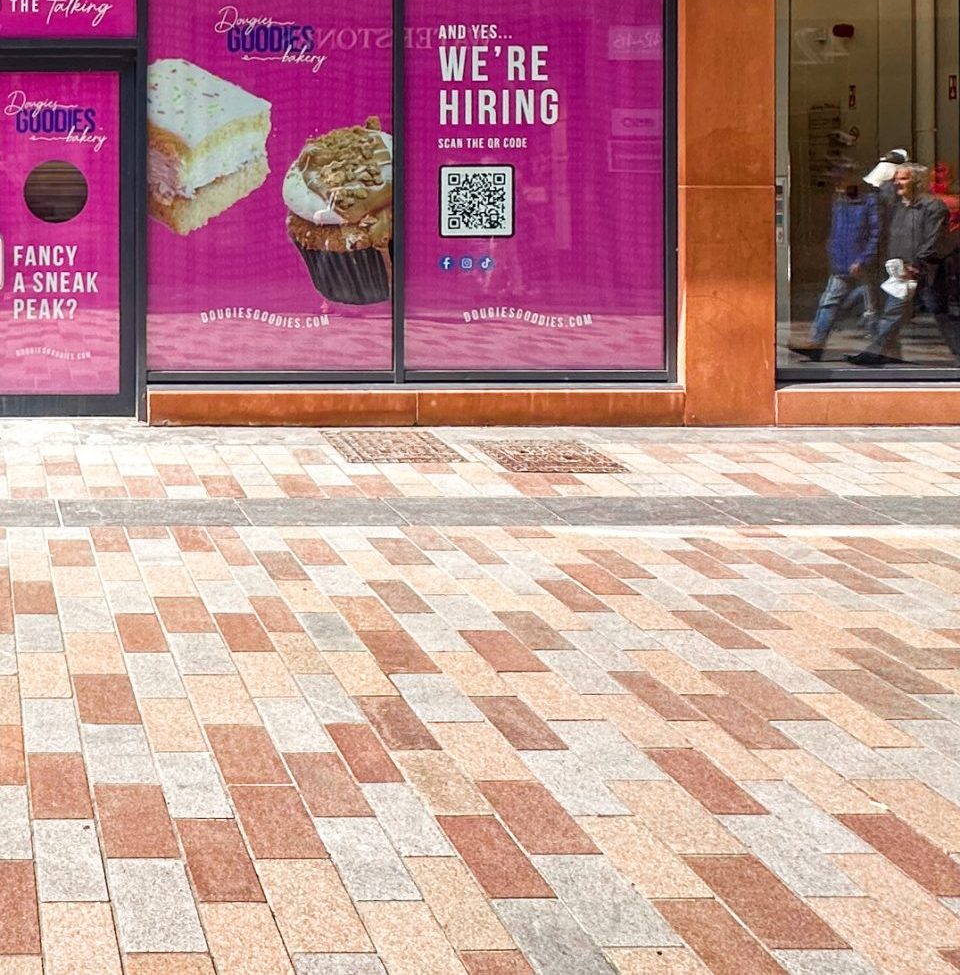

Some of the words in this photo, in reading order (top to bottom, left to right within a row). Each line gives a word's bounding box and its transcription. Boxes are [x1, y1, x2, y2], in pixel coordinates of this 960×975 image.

[214, 6, 295, 36] Dougies
[438, 24, 466, 40] AND
[471, 24, 513, 40] YES...
[227, 26, 315, 53] GOODIES
[241, 45, 328, 73] bakery
[438, 44, 549, 83] WE'RE
[4, 91, 78, 117] Dougies
[438, 88, 560, 125] HIRING
[15, 108, 96, 133] GOODIES
[29, 126, 108, 152] bakery
[438, 138, 462, 149] SCAN
[465, 138, 485, 149] THE
[487, 138, 501, 149] QR
[503, 137, 528, 149] CODE
[13, 245, 78, 266] FANCY
[13, 272, 30, 293] A
[33, 272, 99, 293] SNEAK
[13, 298, 78, 320] PEAK?
[200, 307, 330, 329] DOUGIESGOODIES.COM
[463, 306, 593, 328] DOUGIESGOODIES.COM
